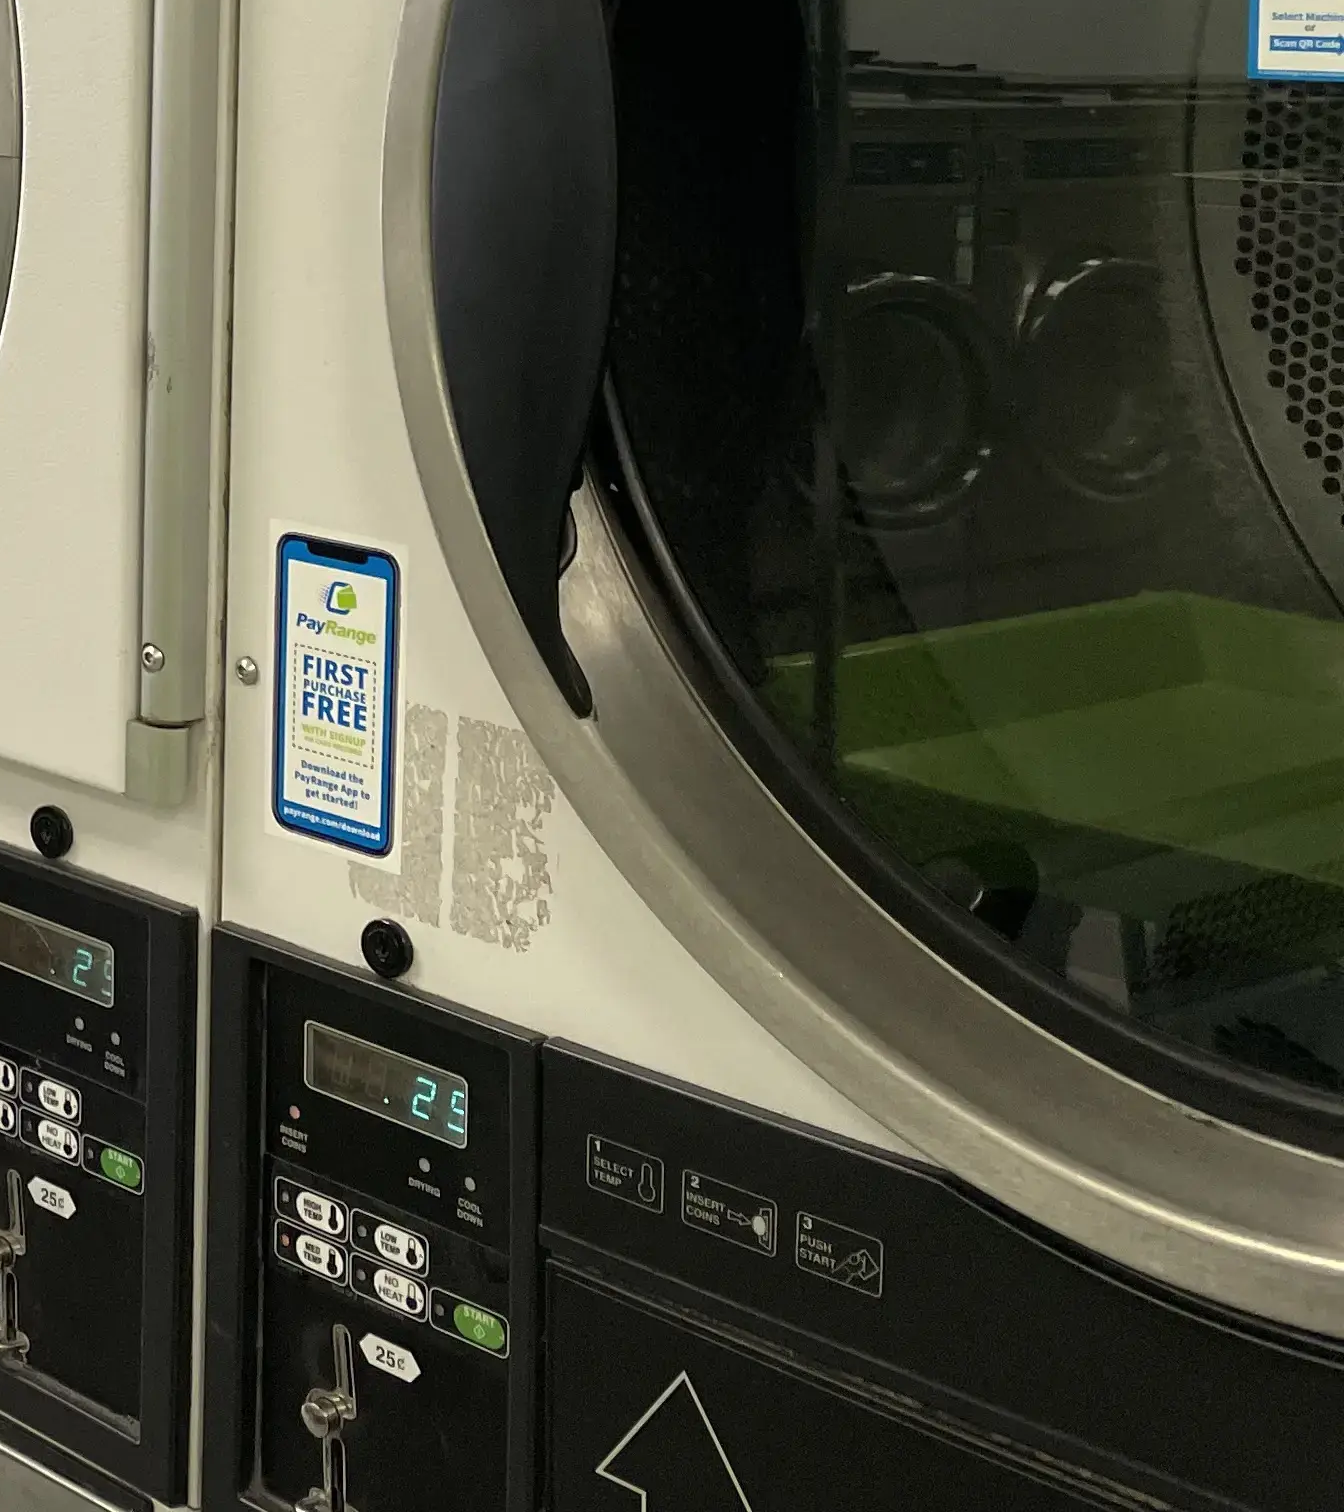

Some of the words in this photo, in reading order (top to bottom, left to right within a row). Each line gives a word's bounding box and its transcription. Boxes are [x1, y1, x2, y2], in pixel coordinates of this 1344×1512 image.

[296, 613, 376, 646] PayRange
[303, 654, 369, 690] FIRST
[303, 678, 366, 704] PURCHASE
[302, 691, 367, 732] FREE
[301, 760, 346, 780] Download
[349, 773, 364, 786] the
[295, 770, 339, 792] PayRange
[341, 784, 358, 798] App
[361, 790, 370, 800] to
[306, 789, 319, 800] get
[46, 1123, 59, 1137] NO
[42, 1132, 62, 1150] HEAT
[594, 1140, 601, 1152] 1
[107, 1148, 133, 1168] START
[594, 1156, 634, 1179] SELECT
[593, 1170, 622, 1187] TEMP
[690, 1176, 700, 1189] 2
[40, 1187, 65, 1210] 25¢
[458, 1197, 482, 1215] COOL
[686, 1191, 726, 1214] INSERT
[303, 1207, 323, 1222] TEMP
[457, 1208, 484, 1228] DOWN
[686, 1205, 720, 1226] COINS
[802, 1217, 812, 1230] 3
[381, 1231, 398, 1245] LOW
[381, 1239, 401, 1255] TEMP
[800, 1234, 832, 1254] PUSH
[303, 1250, 323, 1266] TEMP
[800, 1247, 837, 1270] START
[384, 1273, 400, 1288] NO
[378, 1283, 403, 1303] HEAT
[463, 1308, 495, 1329] START
[375, 1346, 406, 1371] 25¢
